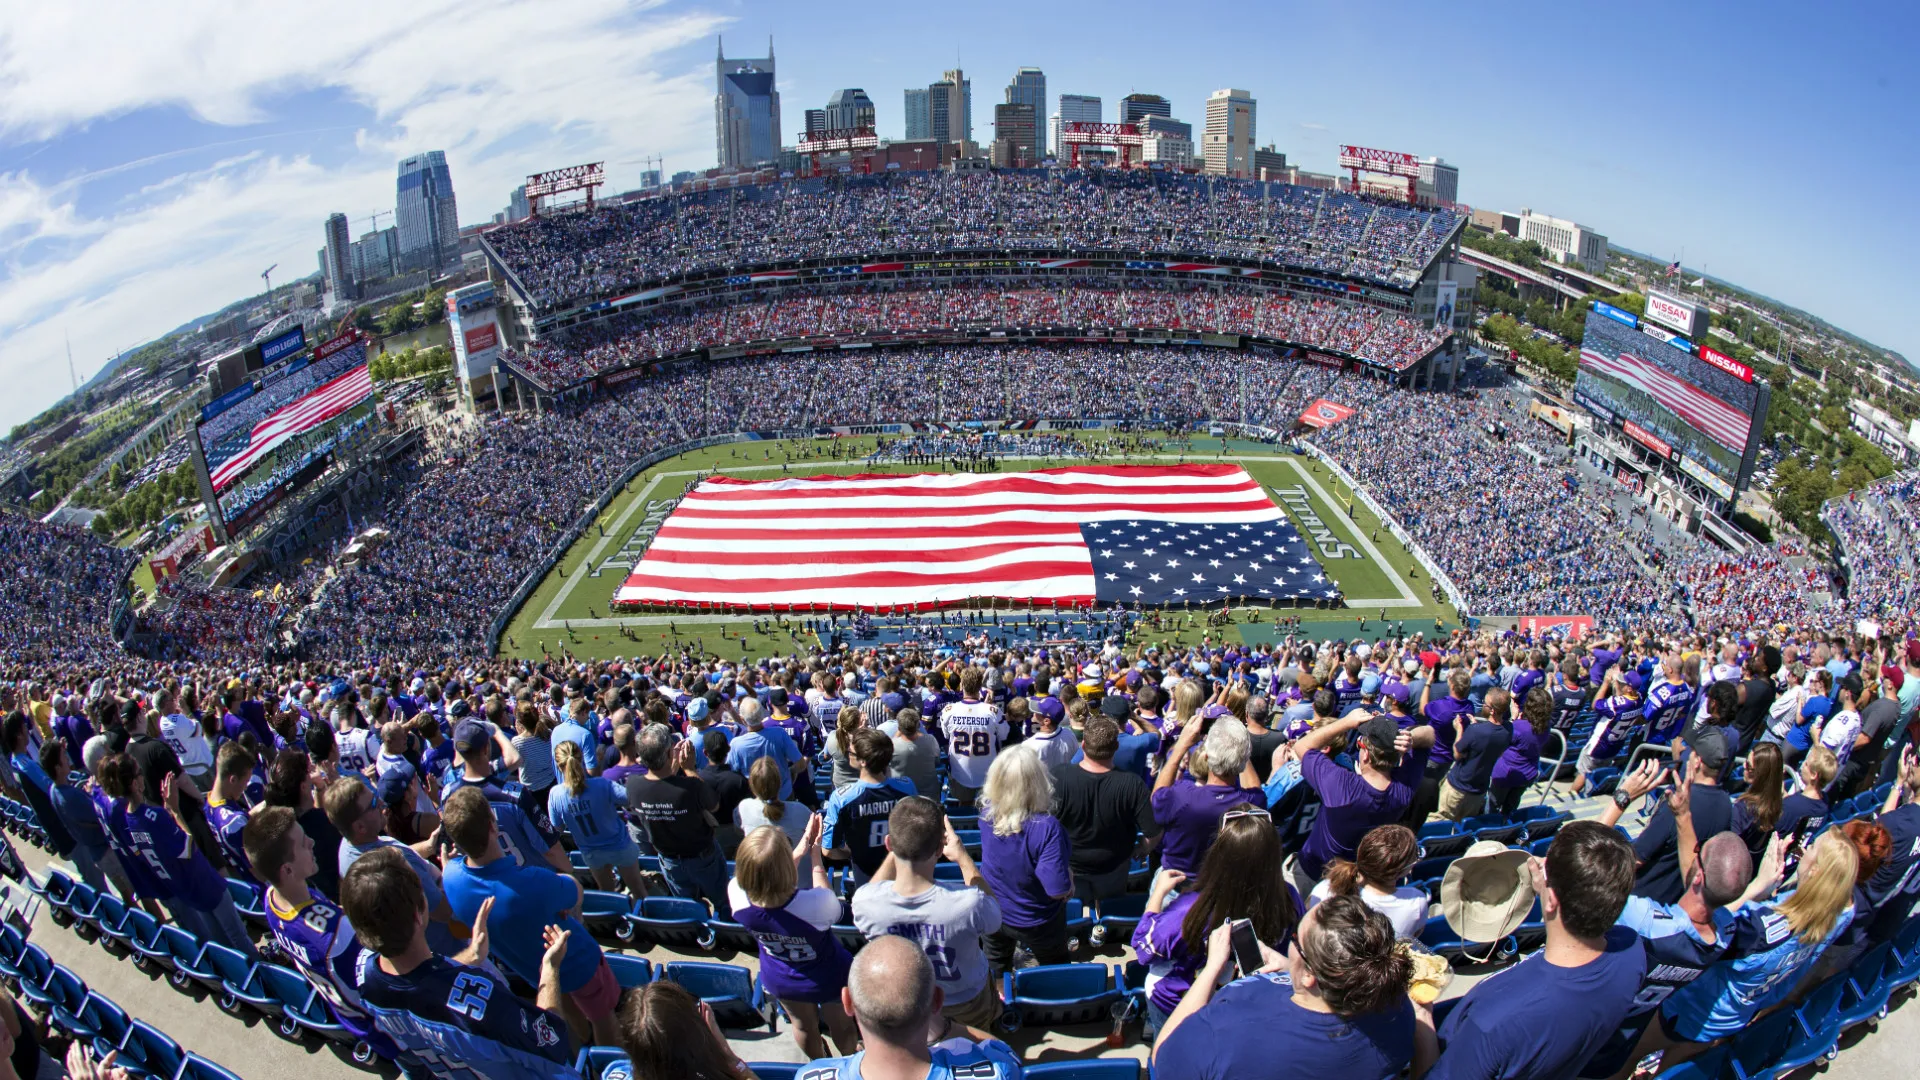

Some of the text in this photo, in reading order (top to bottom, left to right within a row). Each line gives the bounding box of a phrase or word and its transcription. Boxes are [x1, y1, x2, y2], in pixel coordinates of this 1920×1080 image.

[1651, 299, 1688, 321] NISSAN
[1657, 311, 1680, 324] STADIUM
[1643, 325, 1667, 341] Pinnacle
[264, 335, 302, 359] BUD LIGHT
[320, 336, 352, 356] NISSAN
[1307, 353, 1343, 367] NISSAN
[1705, 350, 1746, 377] NISSAN
[607, 370, 641, 384] NISSAN
[1267, 483, 1365, 560] TITANS
[172, 528, 208, 563] NISSAN
[589, 499, 672, 579] TITANS
[953, 716, 991, 727] PETERSON
[1553, 709, 1578, 729] 12
[953, 732, 990, 757] 28
[303, 903, 336, 933] 69
[1761, 909, 1791, 945] 10
[756, 933, 808, 946] PETERSON
[887, 922, 946, 943] SMITH
[445, 971, 494, 1021] 53
